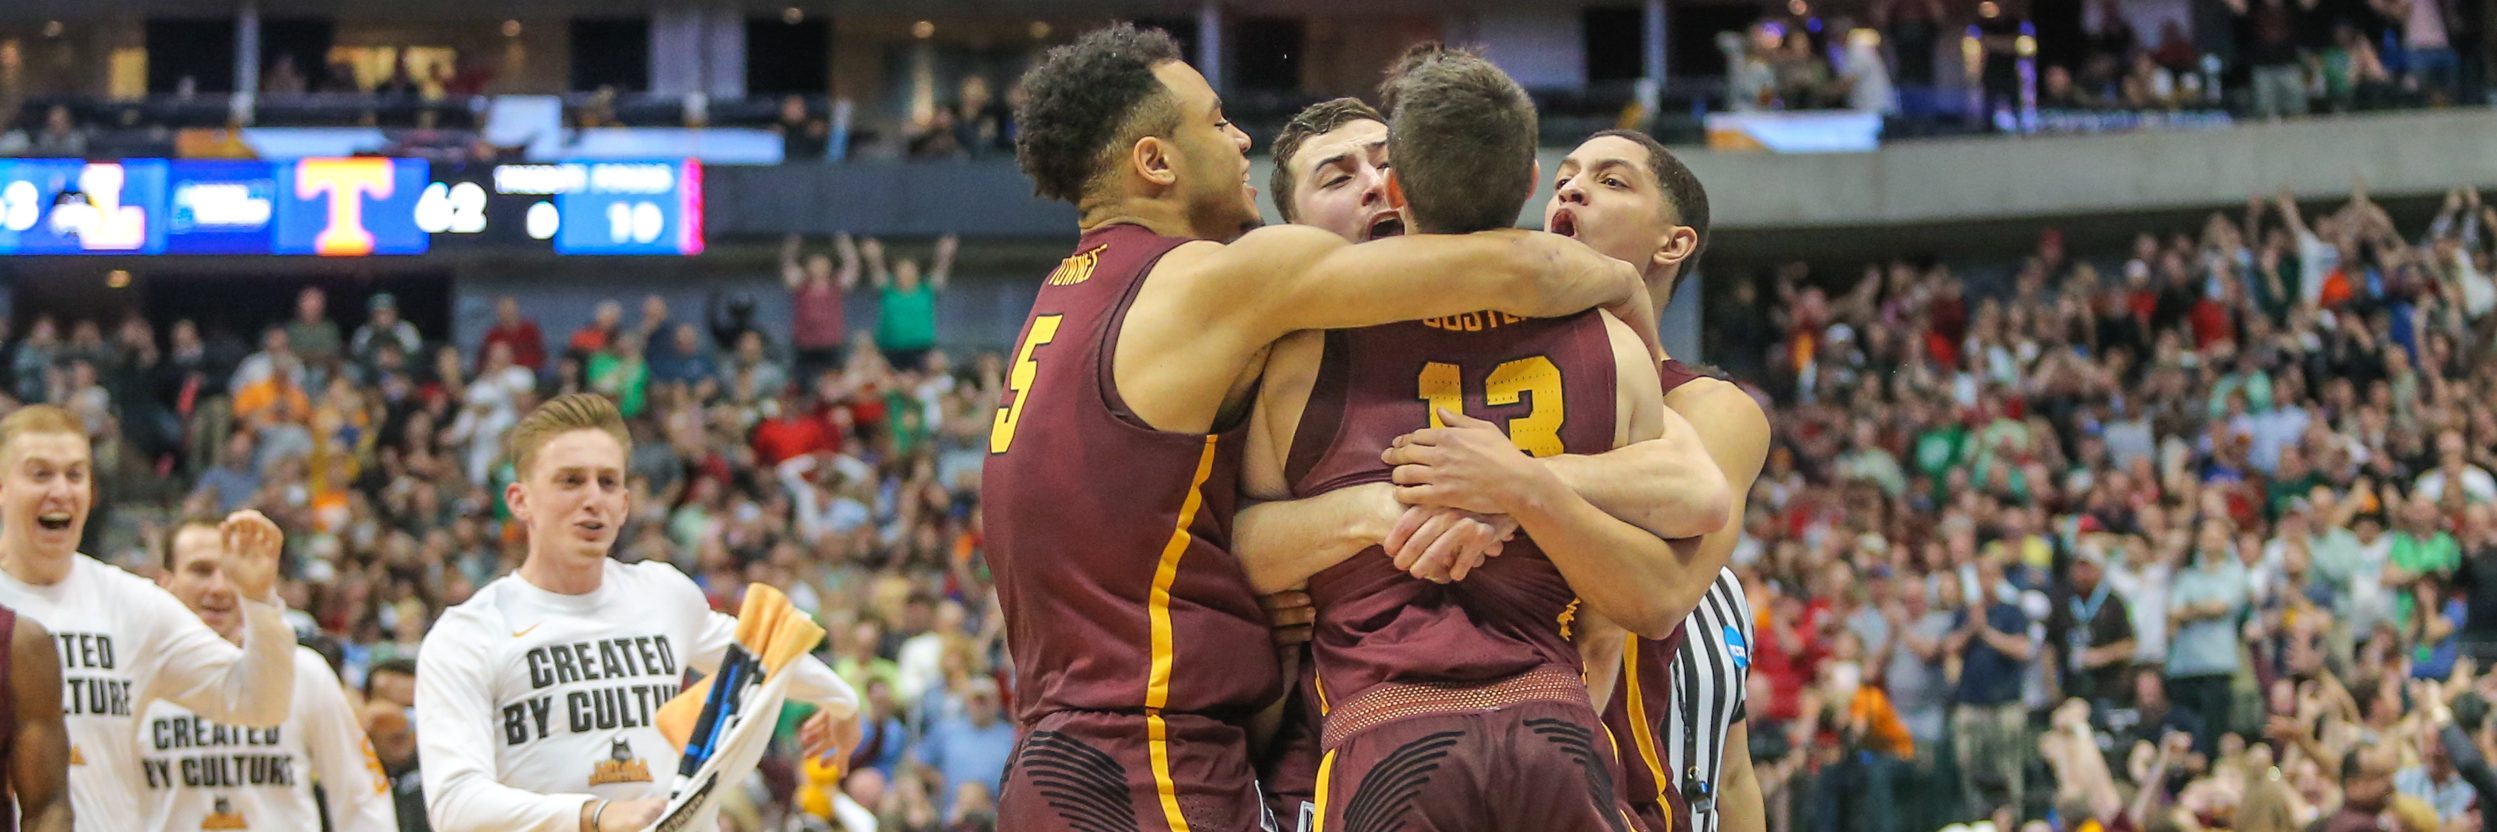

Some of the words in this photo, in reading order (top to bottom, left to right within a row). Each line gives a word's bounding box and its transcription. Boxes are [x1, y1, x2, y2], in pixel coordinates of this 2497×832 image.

[295, 157, 395, 256] T
[414, 182, 487, 234] 62
[607, 201, 664, 244] 10
[990, 314, 1063, 454] 5
[1419, 355, 1565, 459] 13
[50, 632, 114, 669] TED
[527, 634, 676, 690] CREATED
[64, 678, 131, 716] TURE
[503, 694, 553, 746] BY
[568, 684, 679, 733] CULTU
